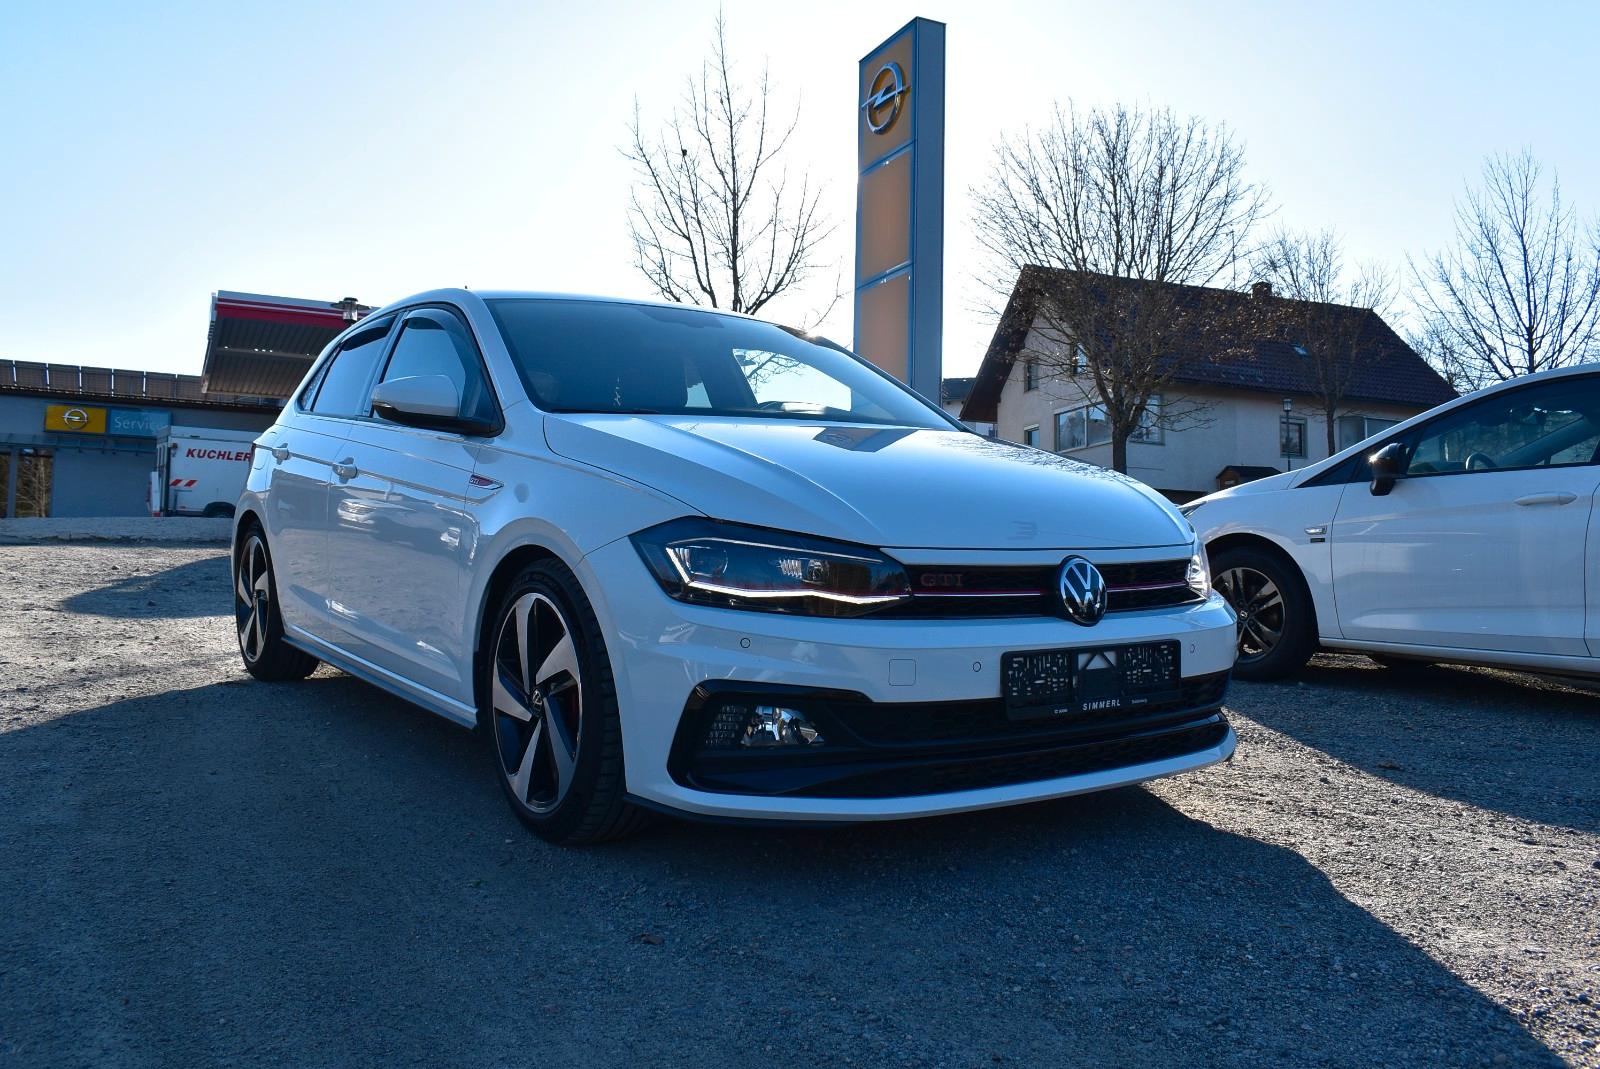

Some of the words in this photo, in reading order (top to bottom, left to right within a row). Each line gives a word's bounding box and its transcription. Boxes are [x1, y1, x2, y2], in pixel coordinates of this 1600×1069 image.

[186, 448, 251, 461] KUCHLER
[920, 573, 963, 586] GTI
[1082, 699, 1121, 711] SIMMERL
